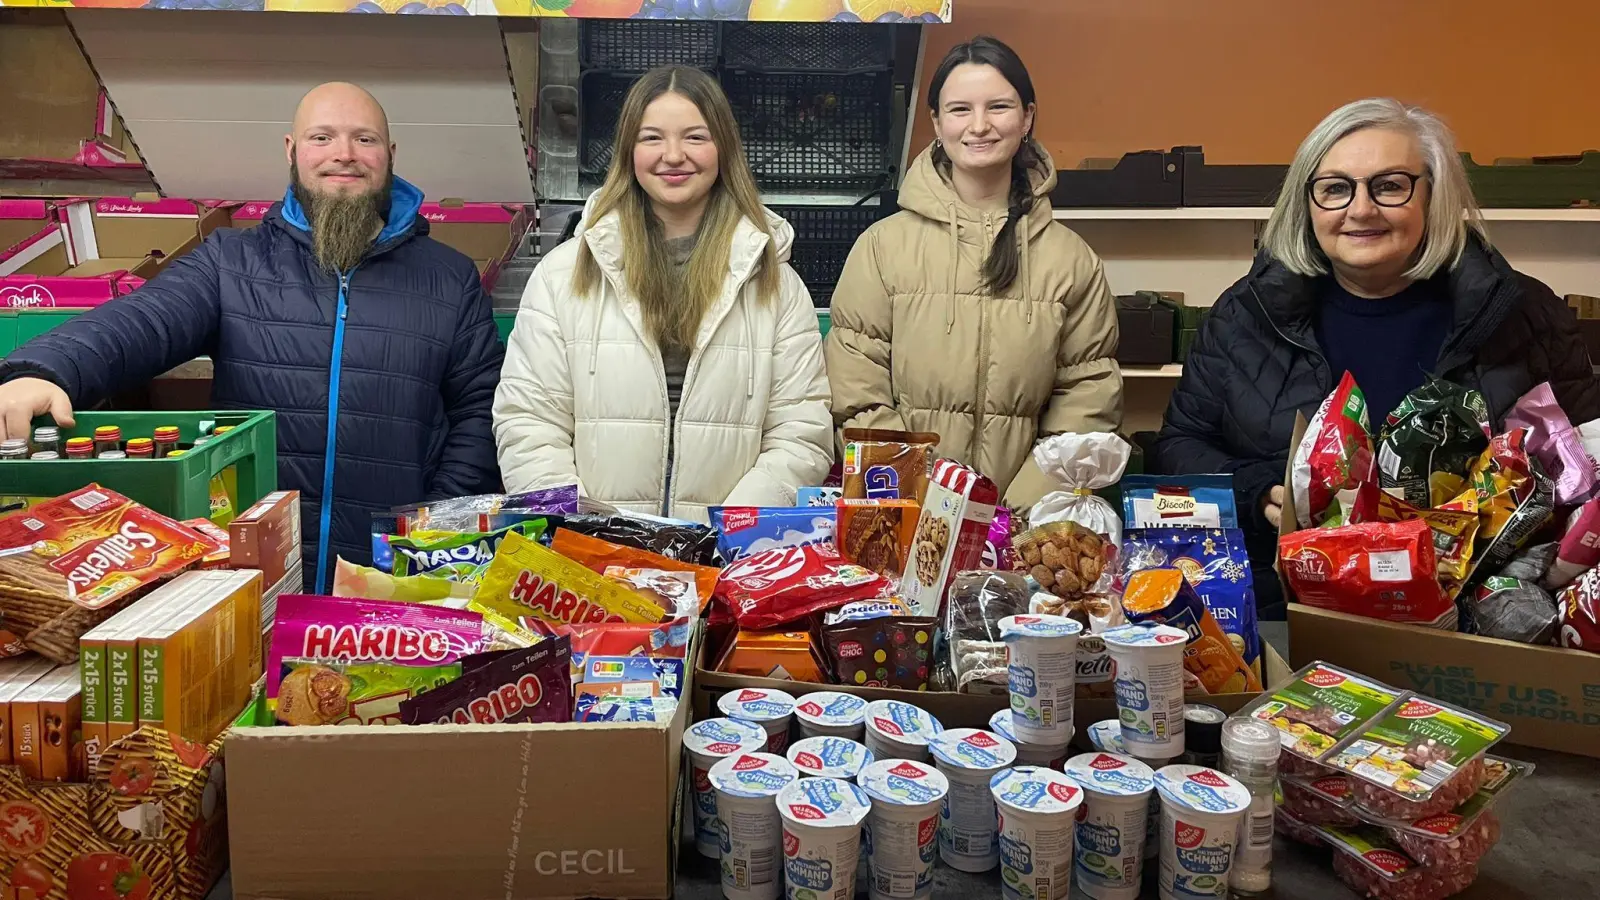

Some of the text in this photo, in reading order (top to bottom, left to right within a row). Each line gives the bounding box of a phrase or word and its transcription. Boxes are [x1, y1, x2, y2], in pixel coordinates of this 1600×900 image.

[8, 289, 43, 307] Pink
[1156, 498, 1194, 510] Biscotto
[67, 520, 157, 587] Saltletts
[402, 537, 503, 571] MAOA
[1295, 560, 1325, 575] SALZ
[622, 600, 637, 612] Zum
[451, 617, 478, 628] Teilen
[303, 624, 450, 662] HARIBO
[511, 650, 549, 672] Zum Teilen
[840, 648, 862, 657] CHOC
[1389, 661, 1475, 679] PLEASE
[437, 672, 543, 724] ARIBO
[1405, 673, 1500, 699] VISIT
[1508, 685, 1569, 706] US:
[1312, 690, 1360, 714] Würfel
[1407, 722, 1463, 747] Würfel
[20, 743, 32, 757] 15
[737, 771, 788, 787] SCHMAND
[534, 848, 636, 875] CECIL
[1180, 849, 1229, 865] SCHMAND
